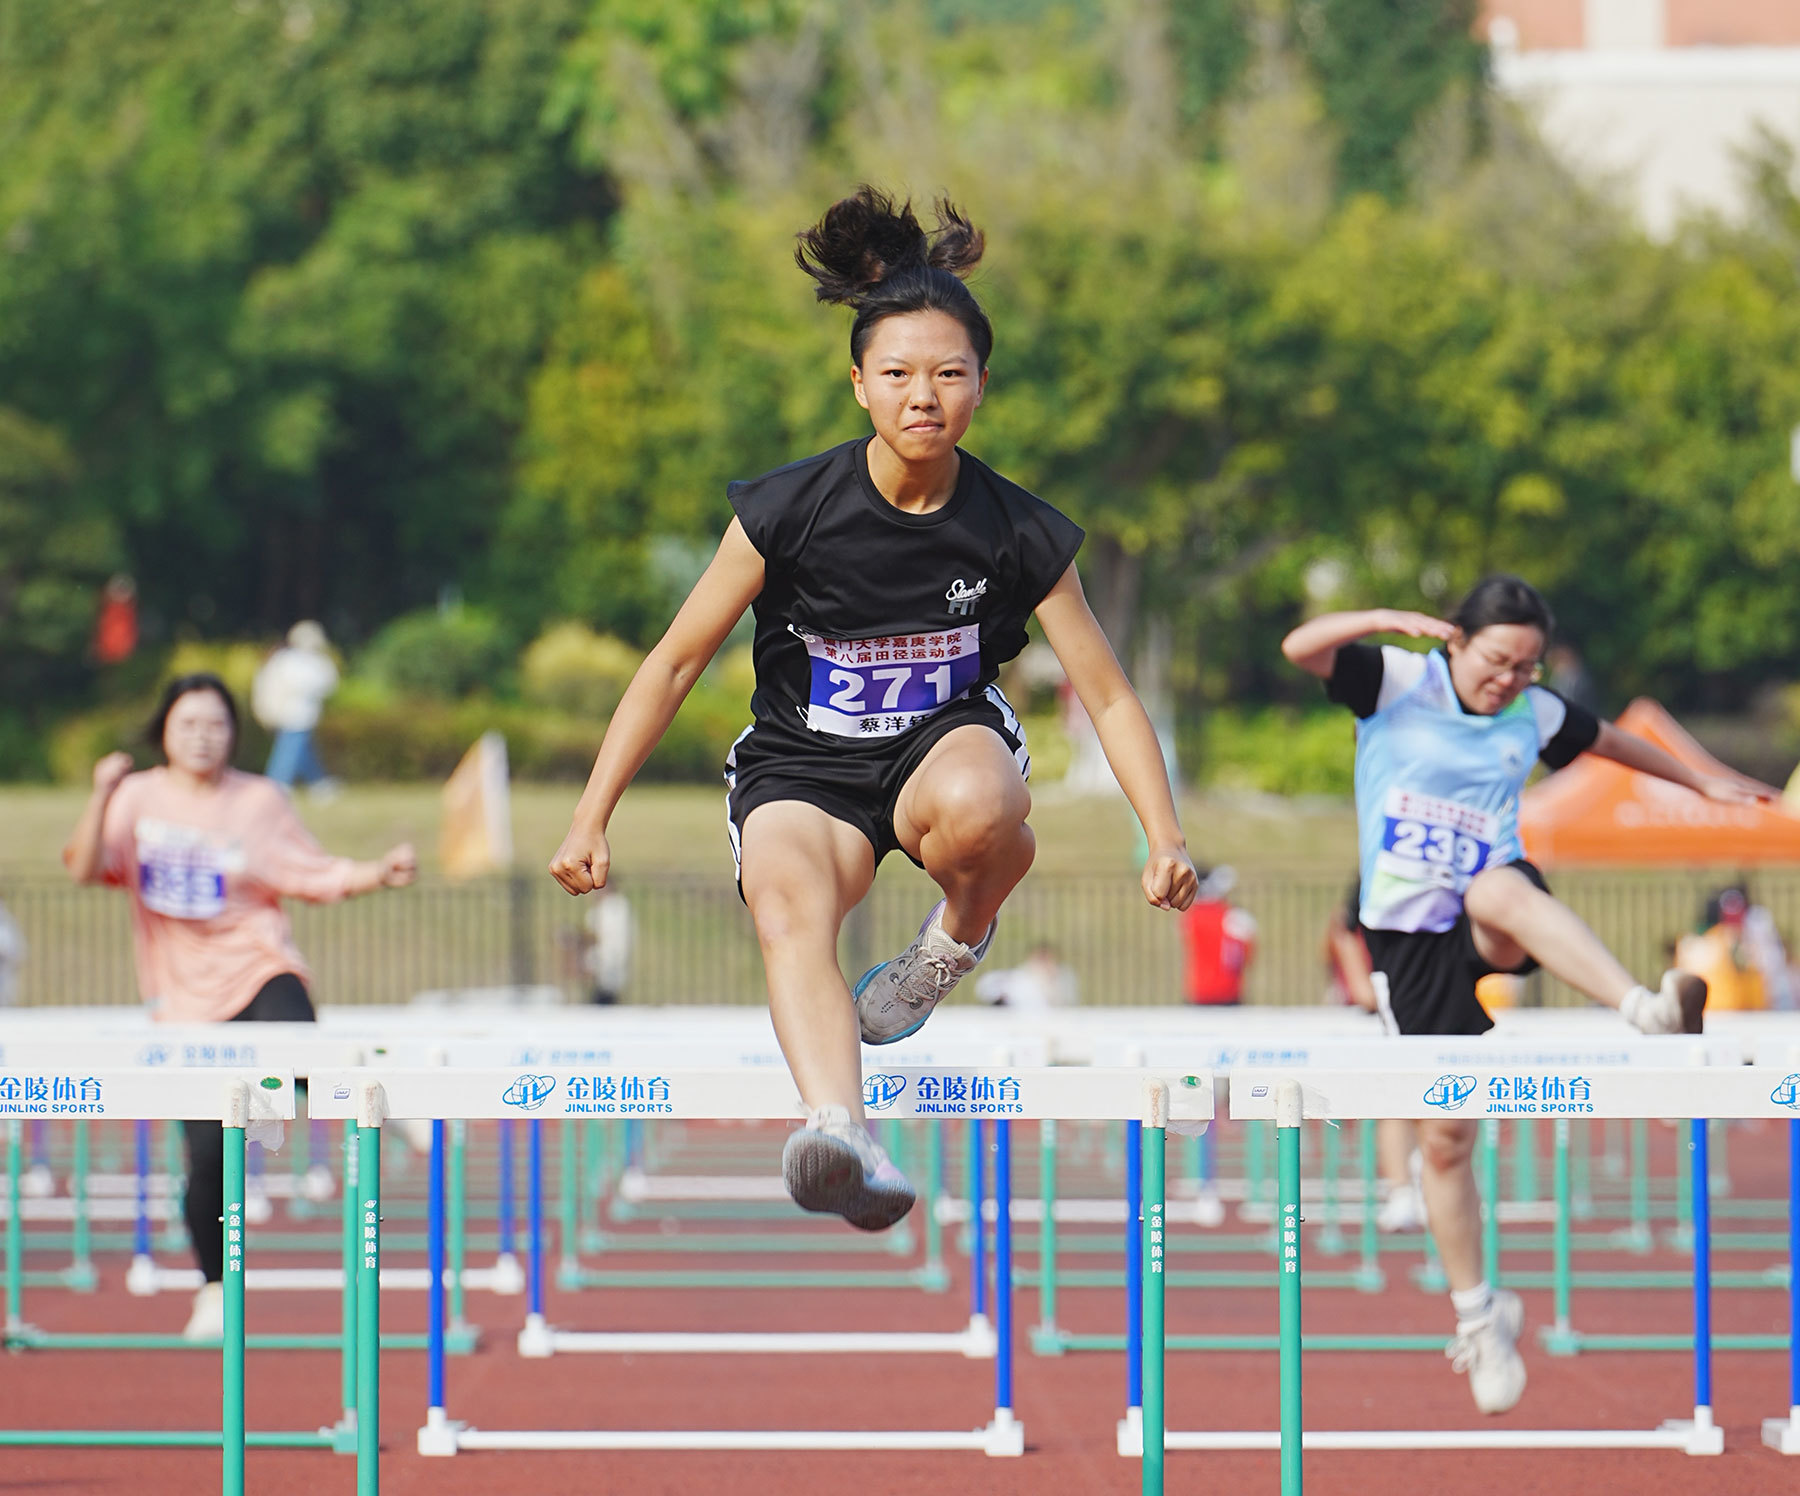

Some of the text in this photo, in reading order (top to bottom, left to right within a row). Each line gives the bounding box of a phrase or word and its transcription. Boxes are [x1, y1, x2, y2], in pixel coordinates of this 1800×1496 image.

[824, 645, 962, 663] 第八届田径运动会
[828, 664, 952, 712] 271
[1391, 820, 1480, 874] 239
[0, 1076, 103, 1101] 金陵体育
[565, 1076, 672, 1101] 金陵体育
[915, 1076, 1022, 1101] 金陵体育
[1487, 1076, 1593, 1101] 金陵体育
[52, 1104, 105, 1113] SPORTS
[565, 1104, 673, 1113] JINLING SPORTS
[915, 1104, 1023, 1113] JINLING SPORTS
[1486, 1104, 1594, 1113] JINLING SPORTS
[228, 1214, 242, 1272] 金陵体育
[364, 1211, 377, 1269] 金陵体育
[1150, 1215, 1163, 1273] 金陵体育
[1283, 1215, 1297, 1273] 金陵体育
